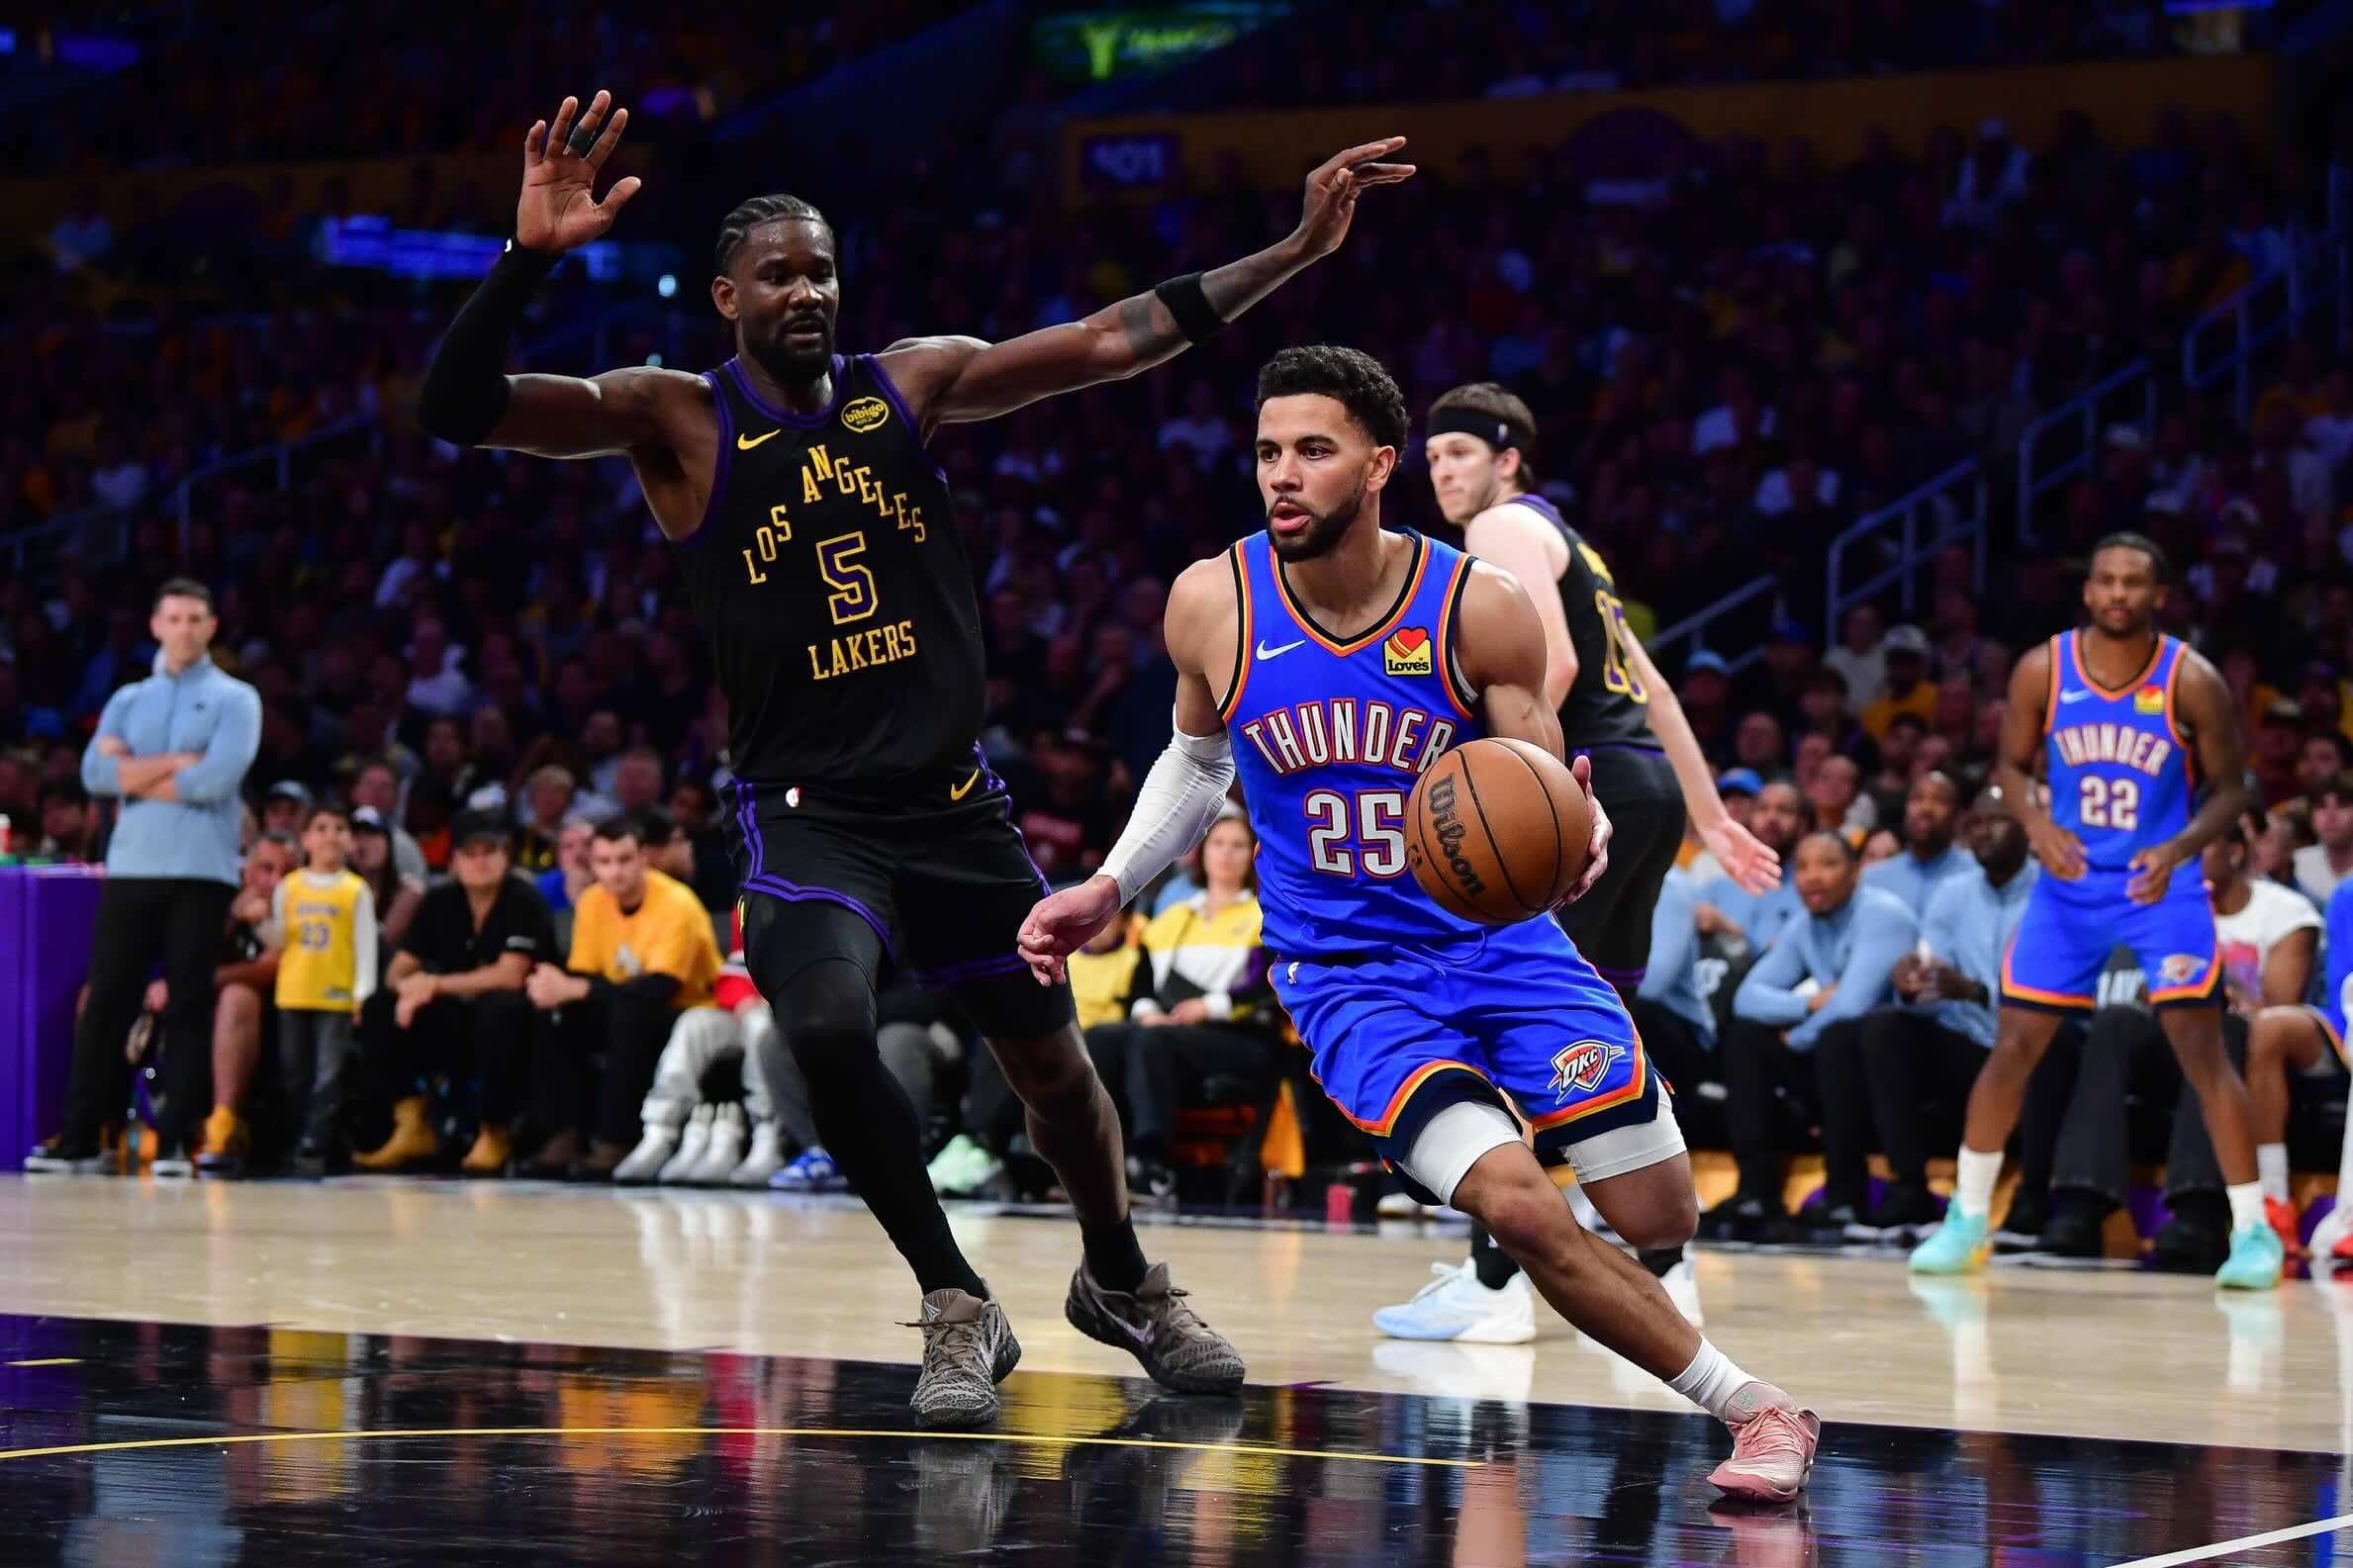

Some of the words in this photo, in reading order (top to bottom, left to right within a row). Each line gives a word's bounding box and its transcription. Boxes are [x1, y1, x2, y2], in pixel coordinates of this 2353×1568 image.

[845, 403, 885, 422] bibigo
[743, 505, 793, 585] LOS
[800, 444, 926, 543] ANGELES
[816, 530, 879, 625] 5
[807, 620, 916, 680] LAKERS
[1243, 697, 1457, 776] THUNDER
[2052, 722, 2171, 776] THUNDER
[1304, 788, 1409, 879] 25
[1428, 772, 1486, 896] Wilson
[2080, 775, 2138, 831] 22
[1561, 1049, 1599, 1089] OKC
